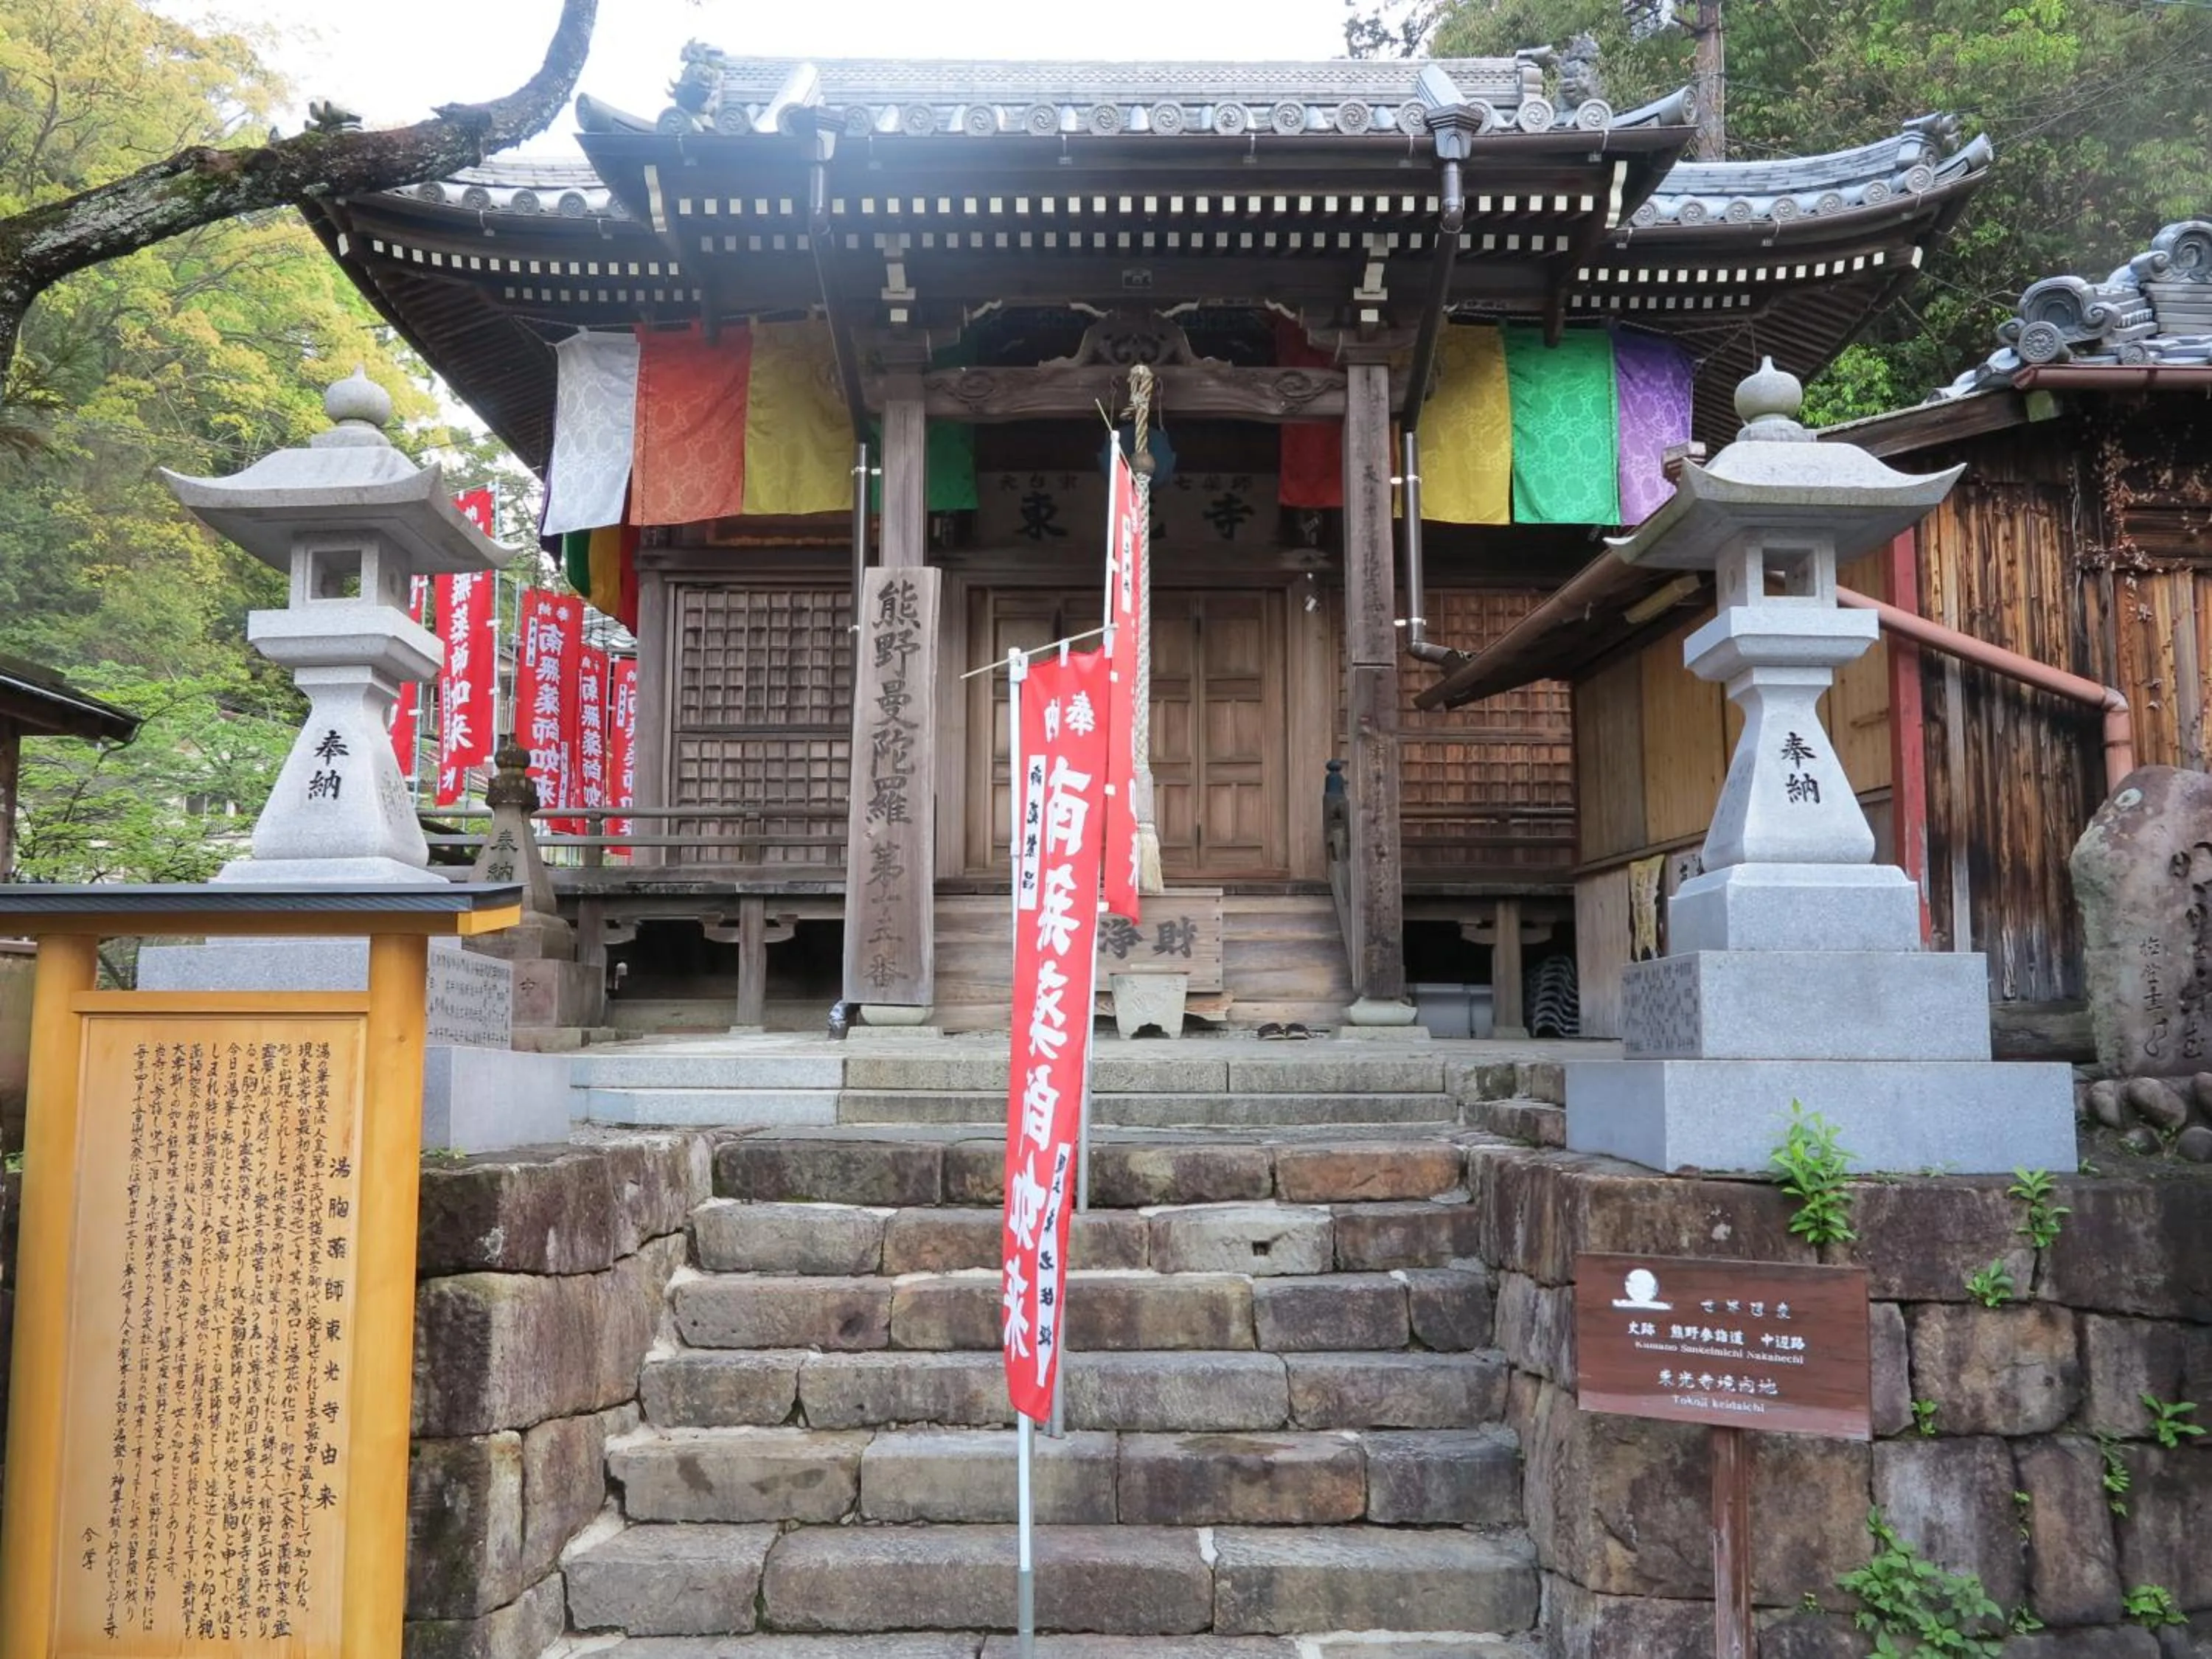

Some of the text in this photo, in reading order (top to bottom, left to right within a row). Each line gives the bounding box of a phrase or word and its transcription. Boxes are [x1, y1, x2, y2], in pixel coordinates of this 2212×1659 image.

[1014, 492, 1255, 540] 東寺
[307, 728, 349, 801] 奉納
[1781, 731, 1821, 804] 奉納
[487, 829, 518, 883] 奉納
[316, 1157, 350, 1509] 湯胸薬師東光寺由来
[1635, 1340, 1678, 1352] Kumano
[1657, 1368, 1779, 1396] 東光寺境内地
